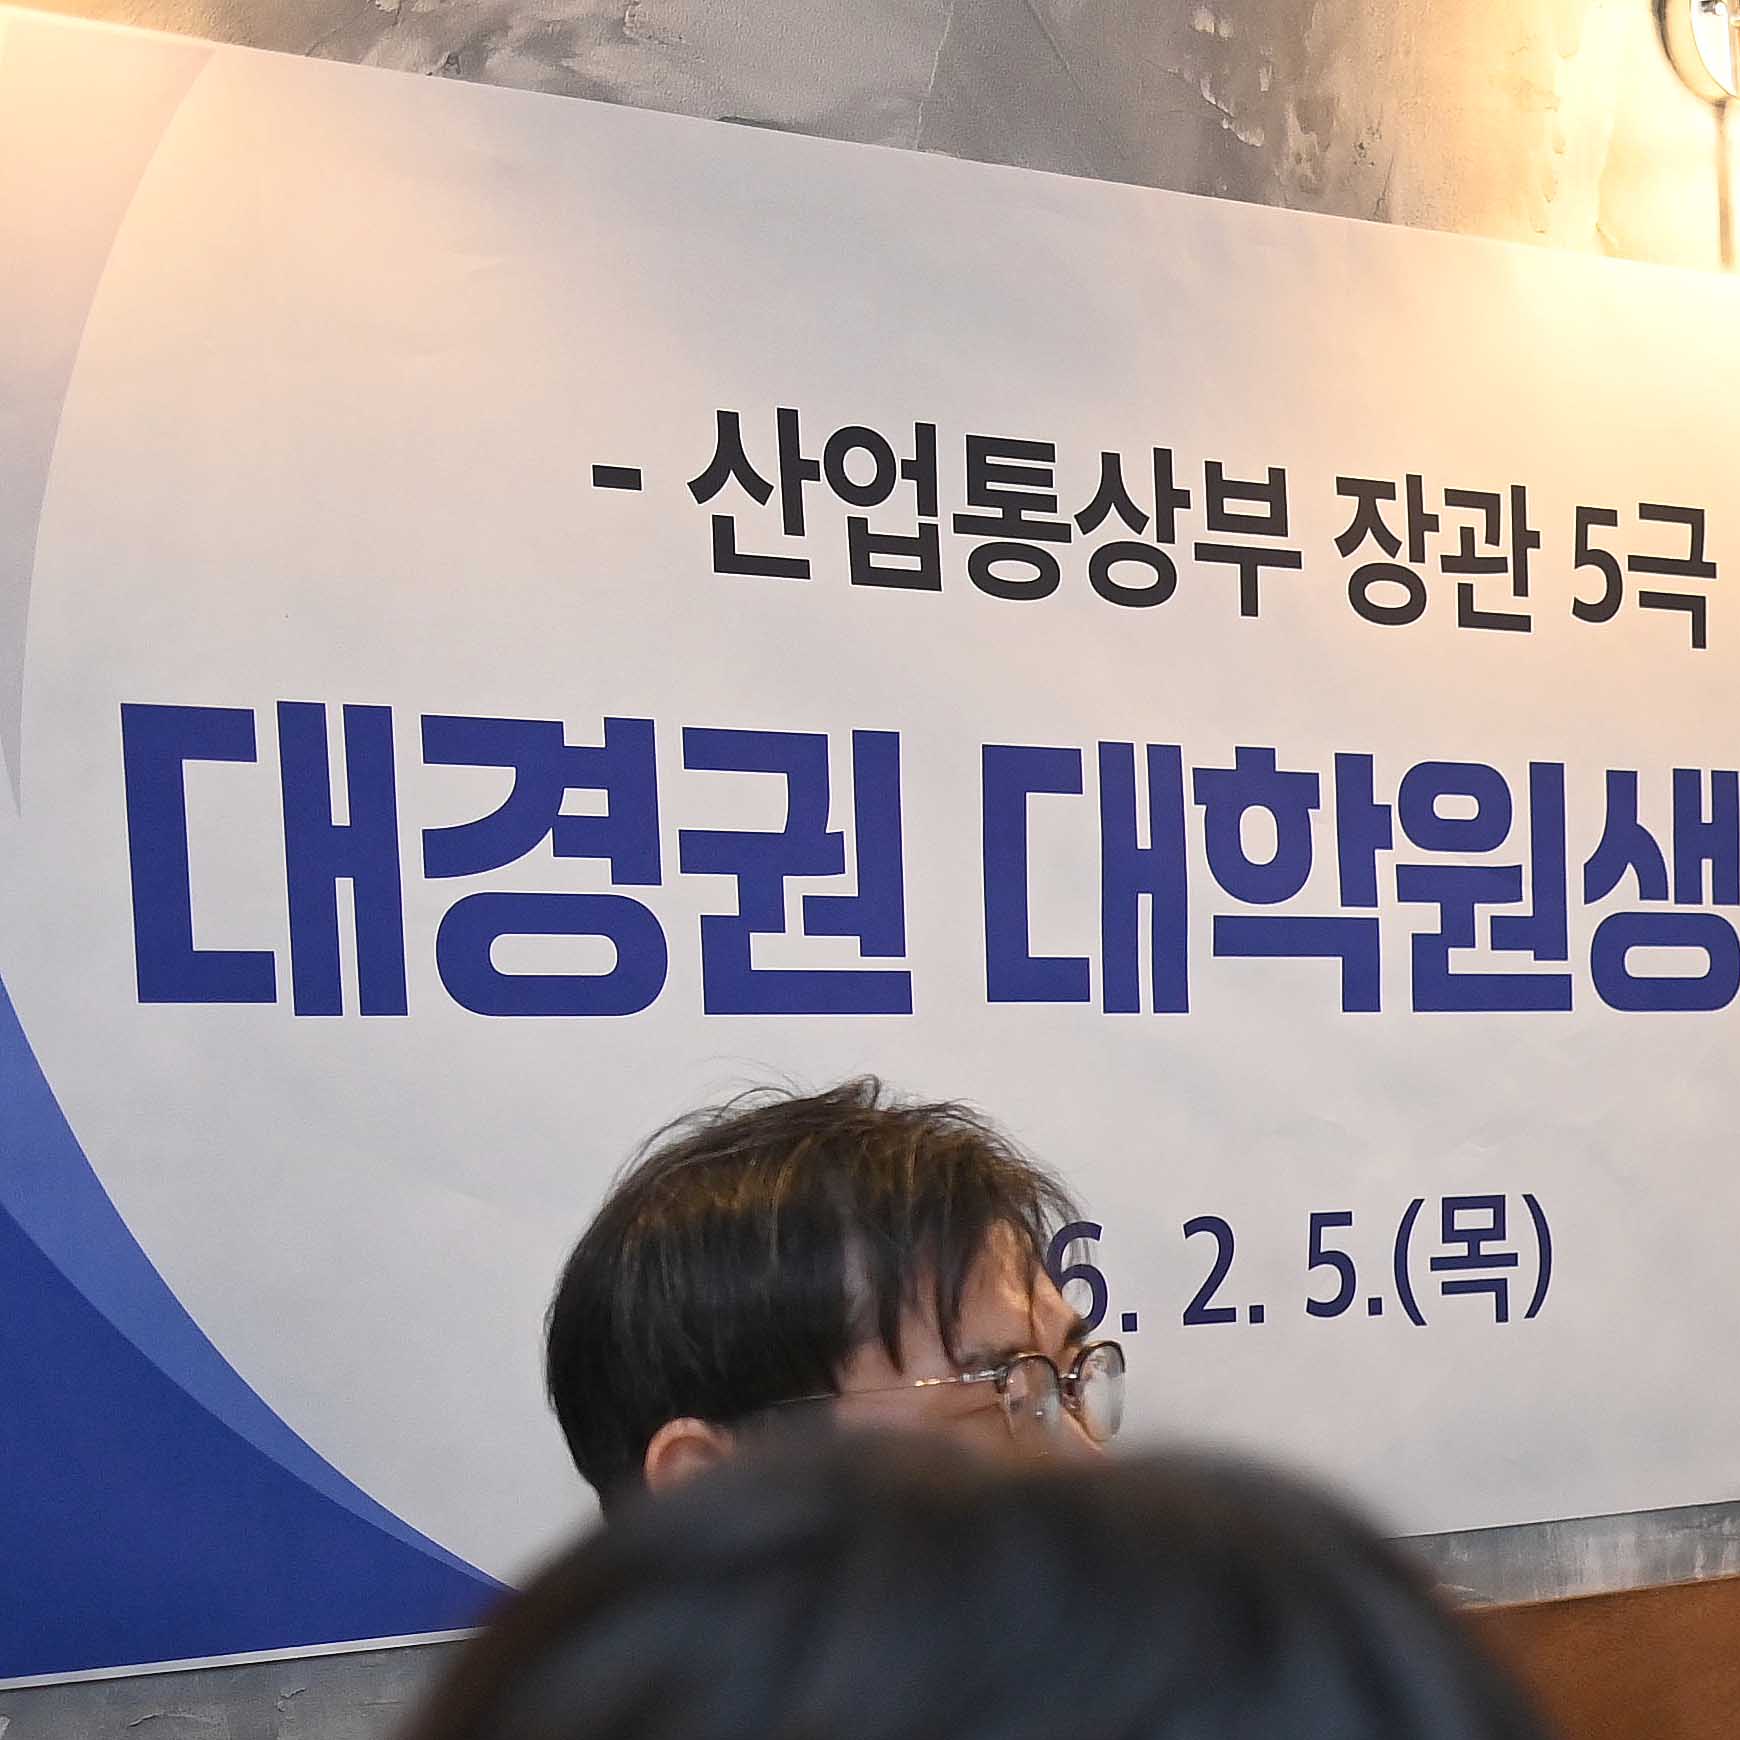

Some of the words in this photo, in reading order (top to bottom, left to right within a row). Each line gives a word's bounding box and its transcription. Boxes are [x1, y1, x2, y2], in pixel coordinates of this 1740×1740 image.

[687, 408, 1302, 617] 산업통상부
[1335, 474, 1540, 632] 장관
[1573, 503, 1716, 649] 5극
[121, 701, 913, 1016] 대경권
[1183, 1216, 1264, 1326] 2.
